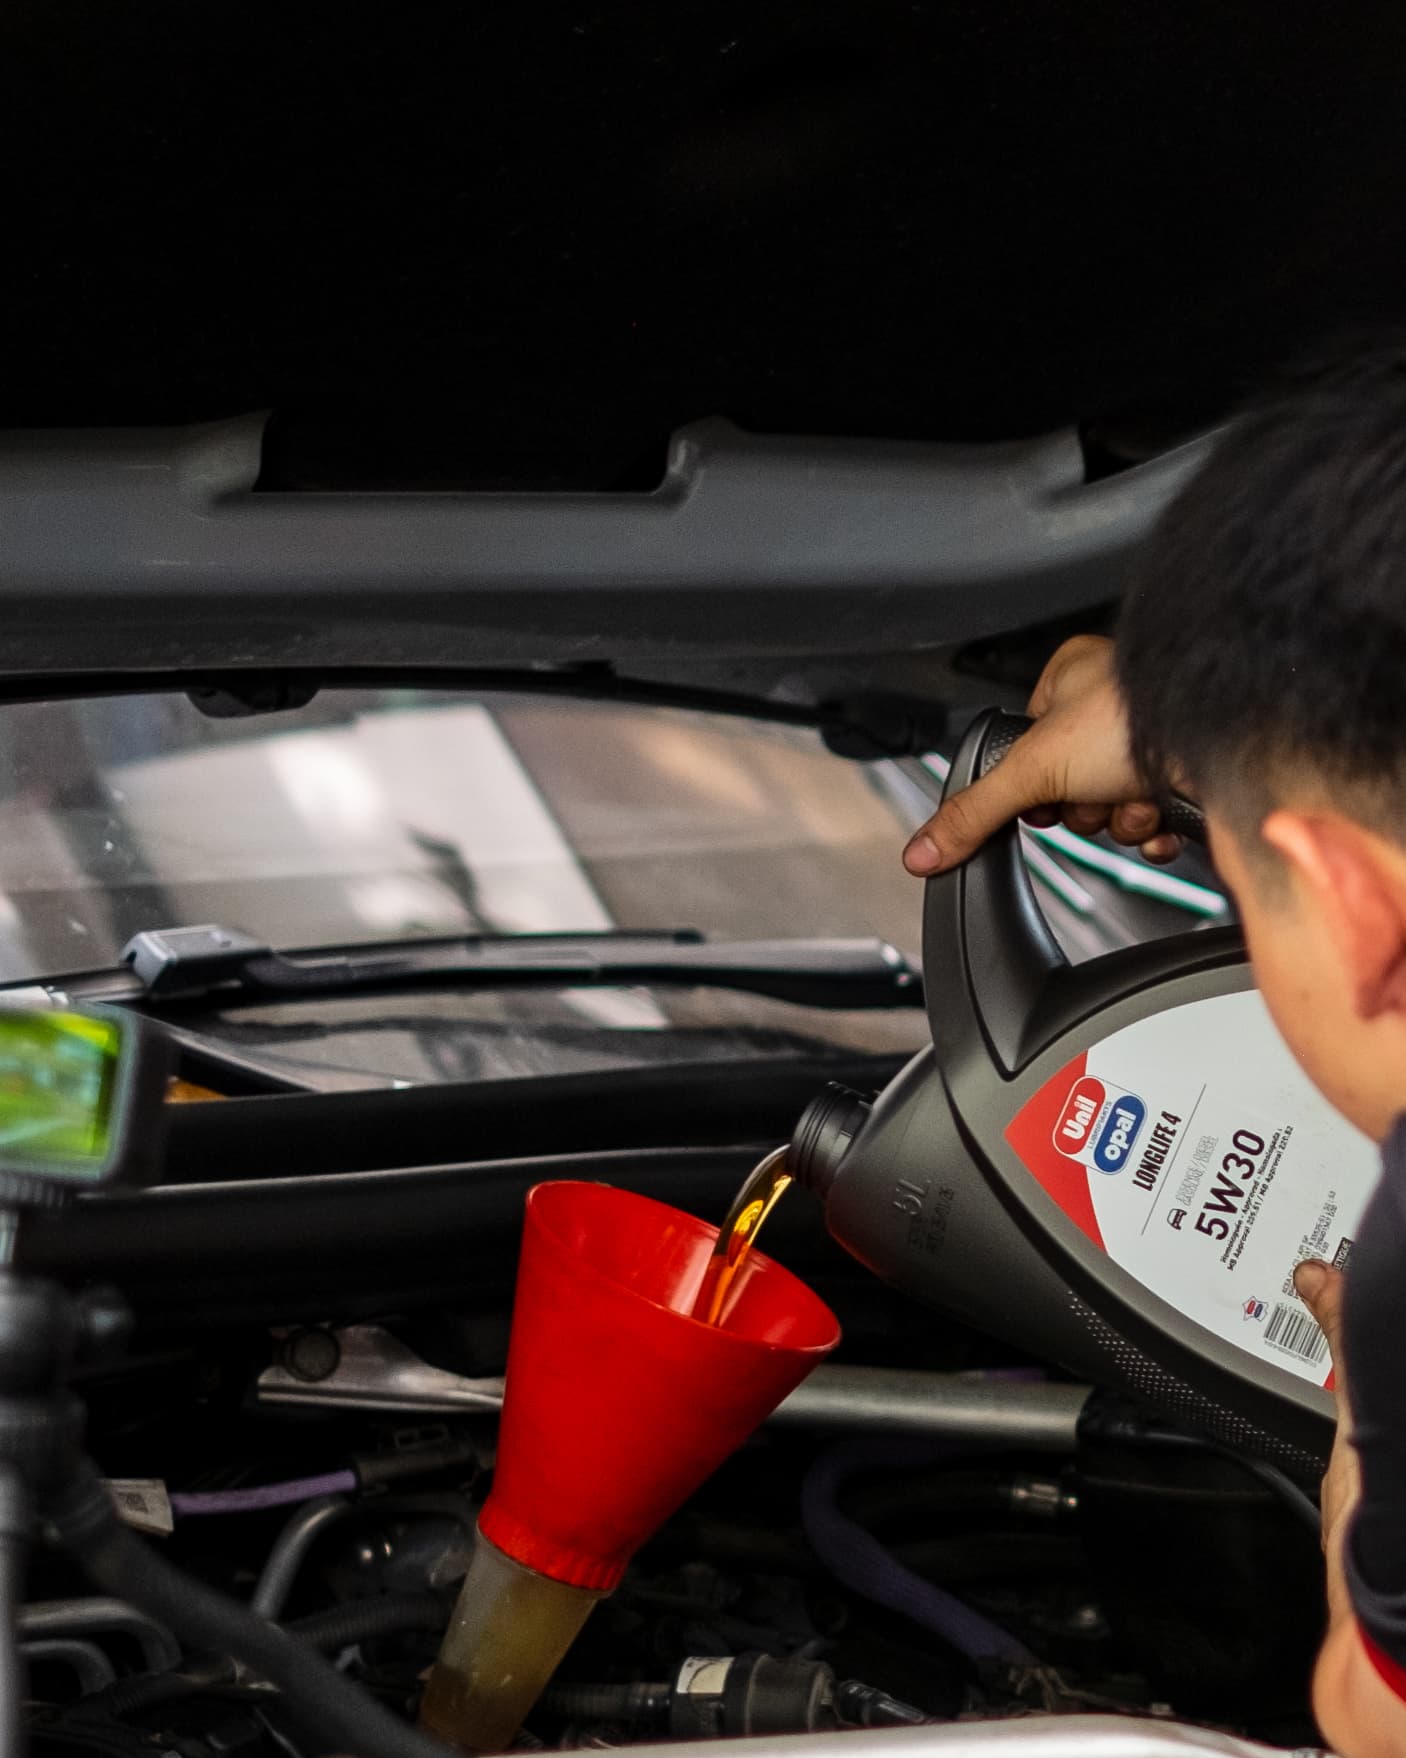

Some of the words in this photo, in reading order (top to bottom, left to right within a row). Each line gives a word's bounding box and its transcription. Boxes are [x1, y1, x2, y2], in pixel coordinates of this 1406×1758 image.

[1062, 1094, 1098, 1140] Unil
[1104, 1107, 1137, 1161] opal
[1132, 1122, 1177, 1191] LONGLIFE
[1161, 1110, 1181, 1125] 4
[1194, 1129, 1265, 1240] 5W30
